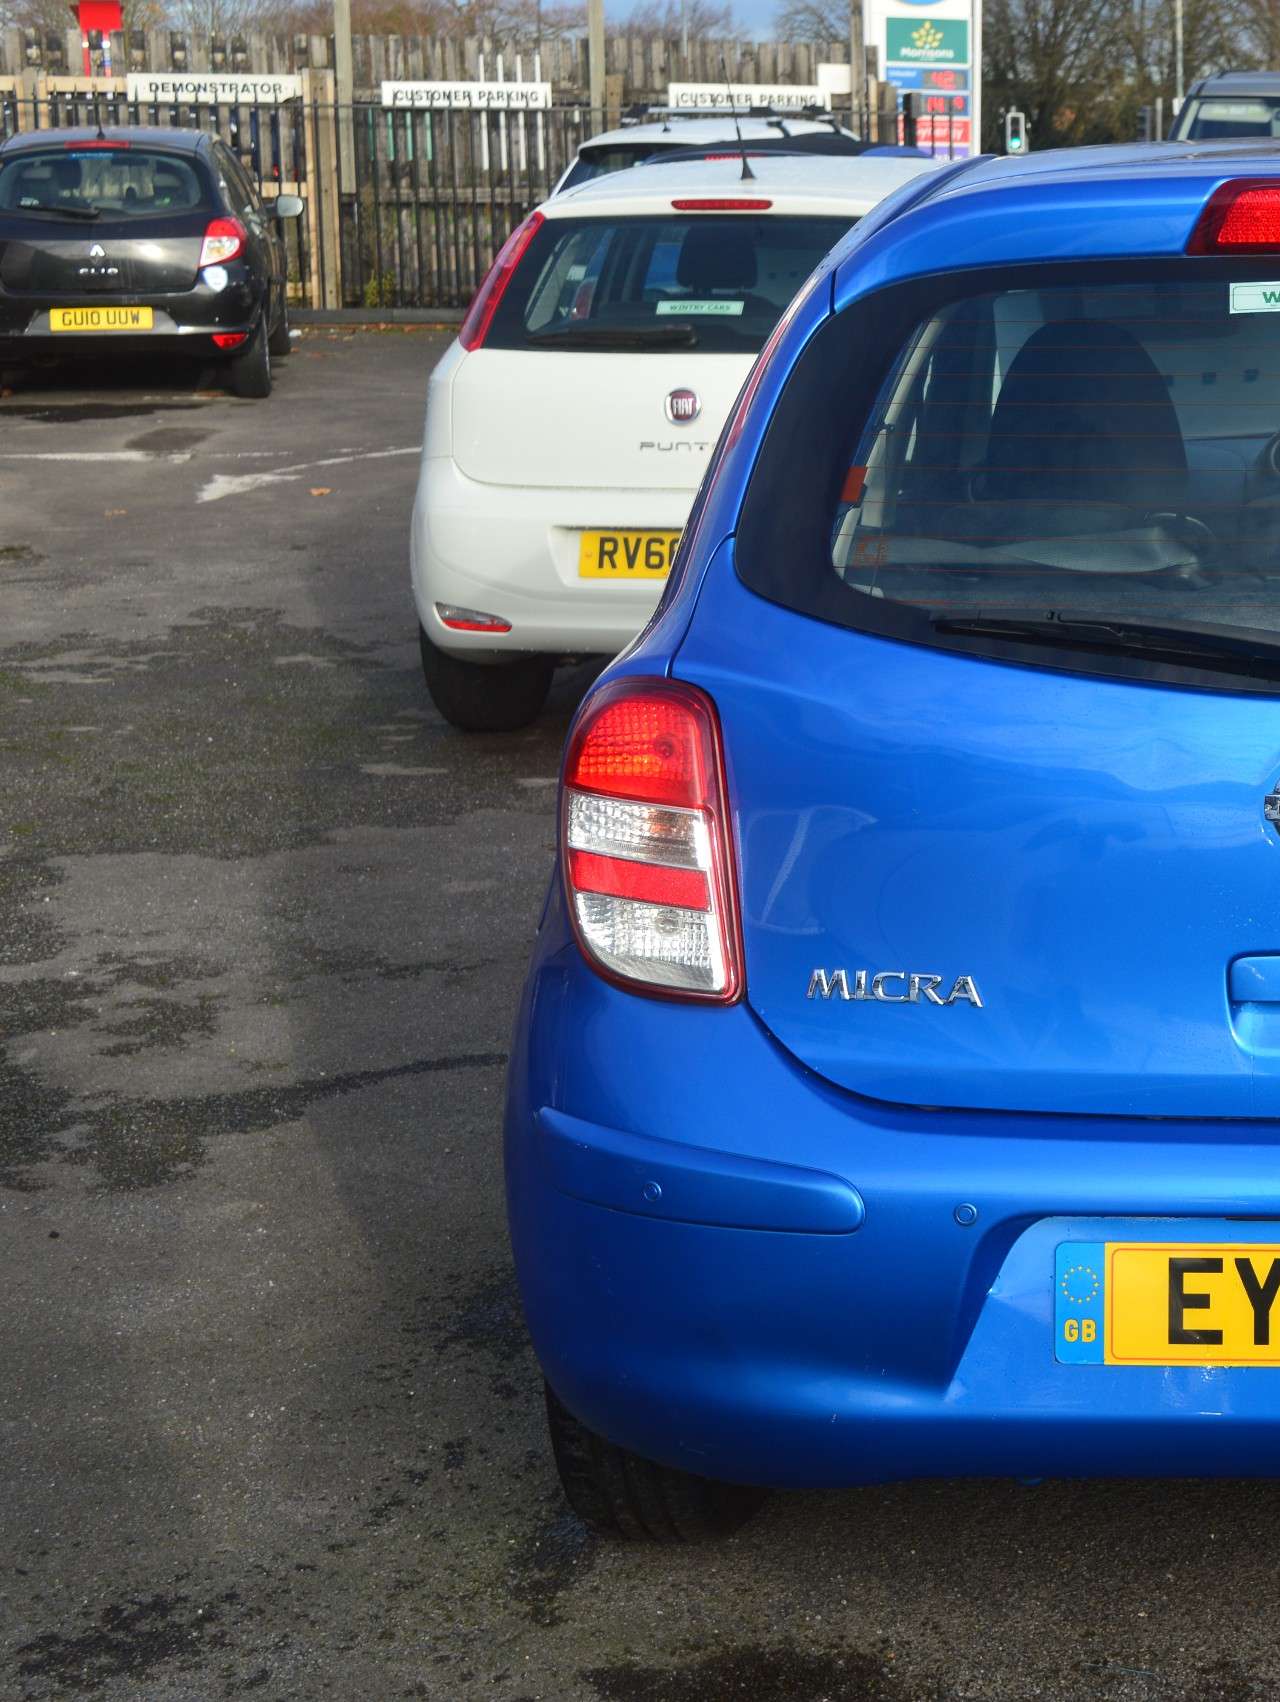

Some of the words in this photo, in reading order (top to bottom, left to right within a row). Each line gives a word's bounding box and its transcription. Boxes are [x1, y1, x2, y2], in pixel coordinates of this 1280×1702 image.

[900, 47, 955, 59] Morrisons
[149, 82, 282, 94] DEMONSTRATOR
[395, 90, 471, 102] CUSTOMER
[478, 91, 539, 102] PARKING
[680, 92, 752, 104] CUSTOMER
[759, 94, 817, 105] PARKING
[669, 303, 704, 312] WINTRY
[707, 303, 731, 312] CARS
[62, 311, 101, 327] GU10
[106, 310, 140, 325] UUW
[672, 397, 695, 416] FIAT
[639, 441, 715, 452] PUNT
[806, 967, 984, 1008] MICRA
[1064, 1319, 1097, 1343] GB
